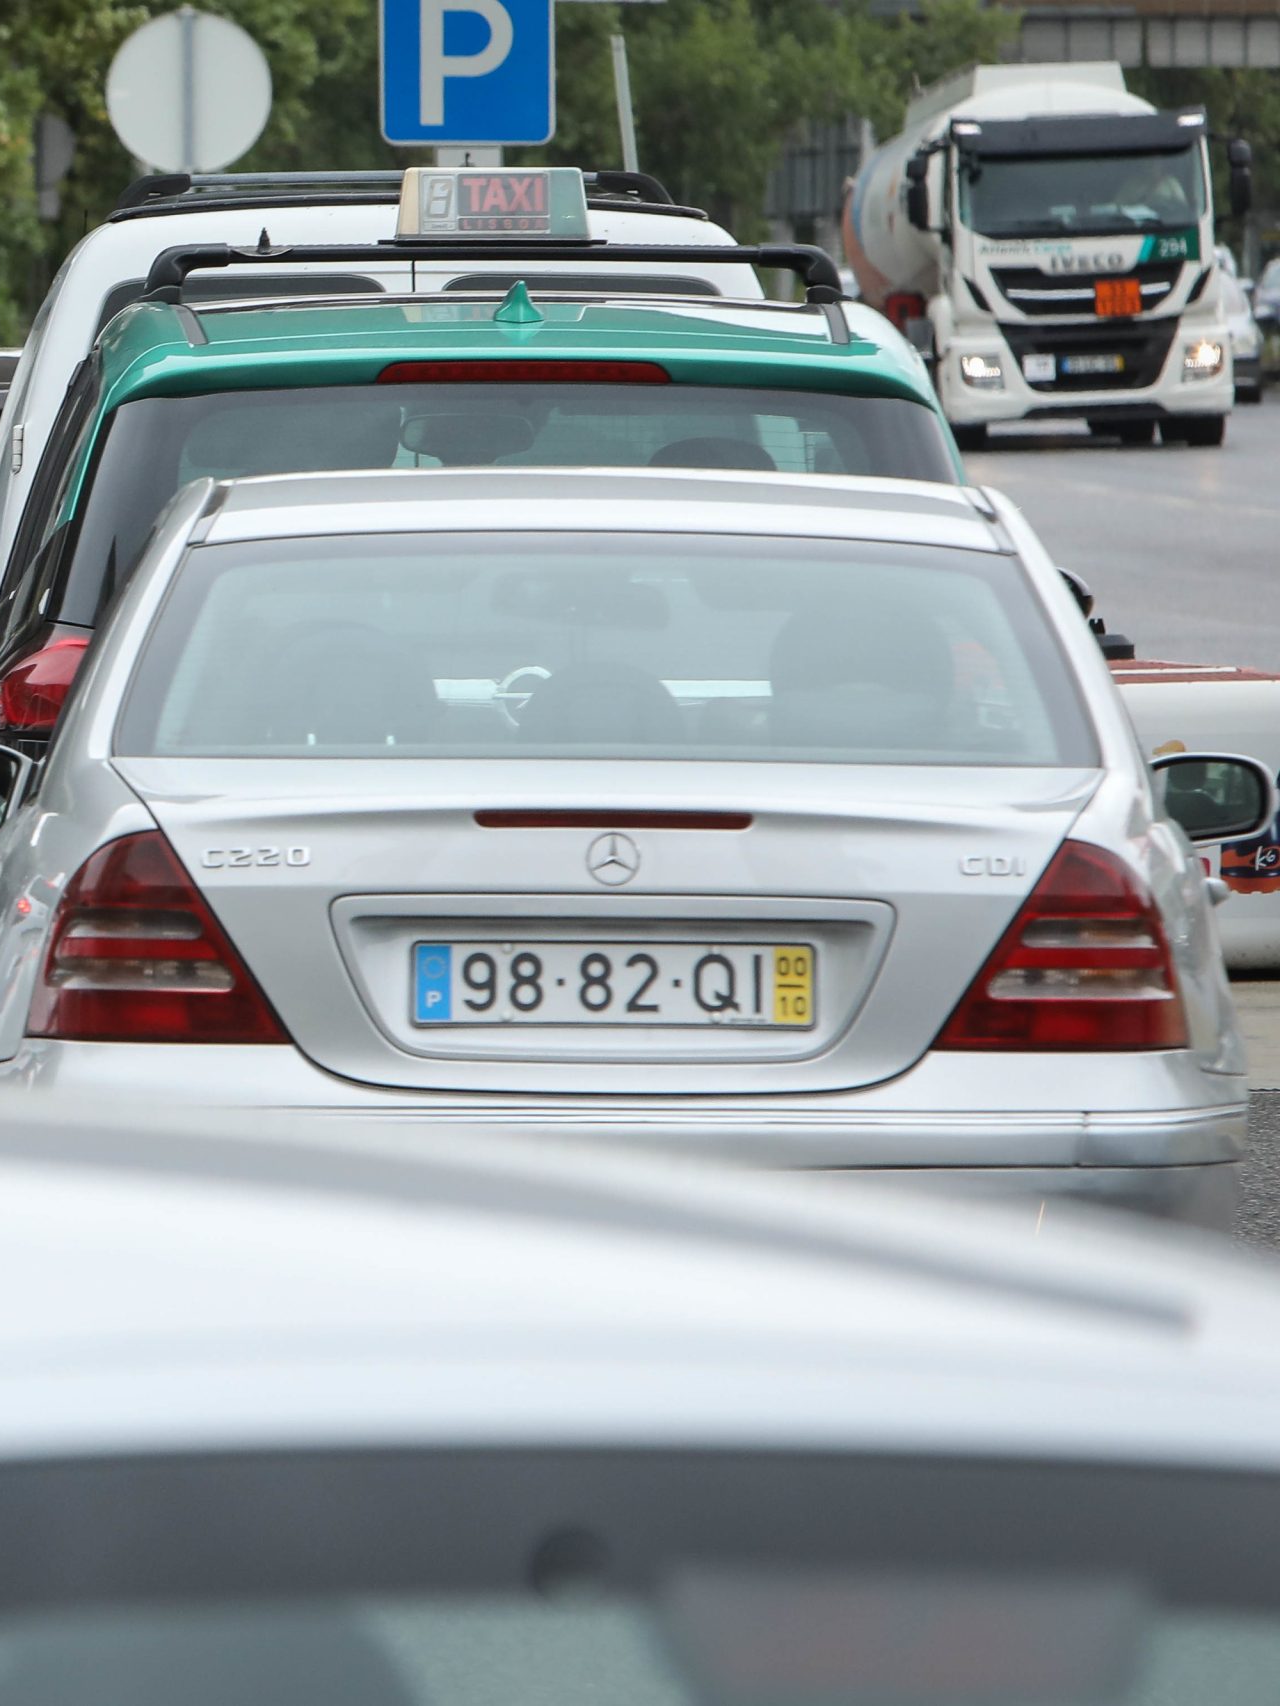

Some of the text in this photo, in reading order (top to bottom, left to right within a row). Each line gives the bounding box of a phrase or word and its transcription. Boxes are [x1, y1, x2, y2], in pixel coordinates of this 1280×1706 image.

[420, 0, 513, 125] P
[463, 177, 544, 212] TAXI
[463, 219, 545, 230] LISBOA
[1051, 254, 1123, 271] IVECO
[202, 847, 311, 868] C220
[960, 856, 1024, 876] CDI
[777, 956, 806, 977] 00
[426, 991, 442, 1006] P
[779, 996, 806, 1016] 10
